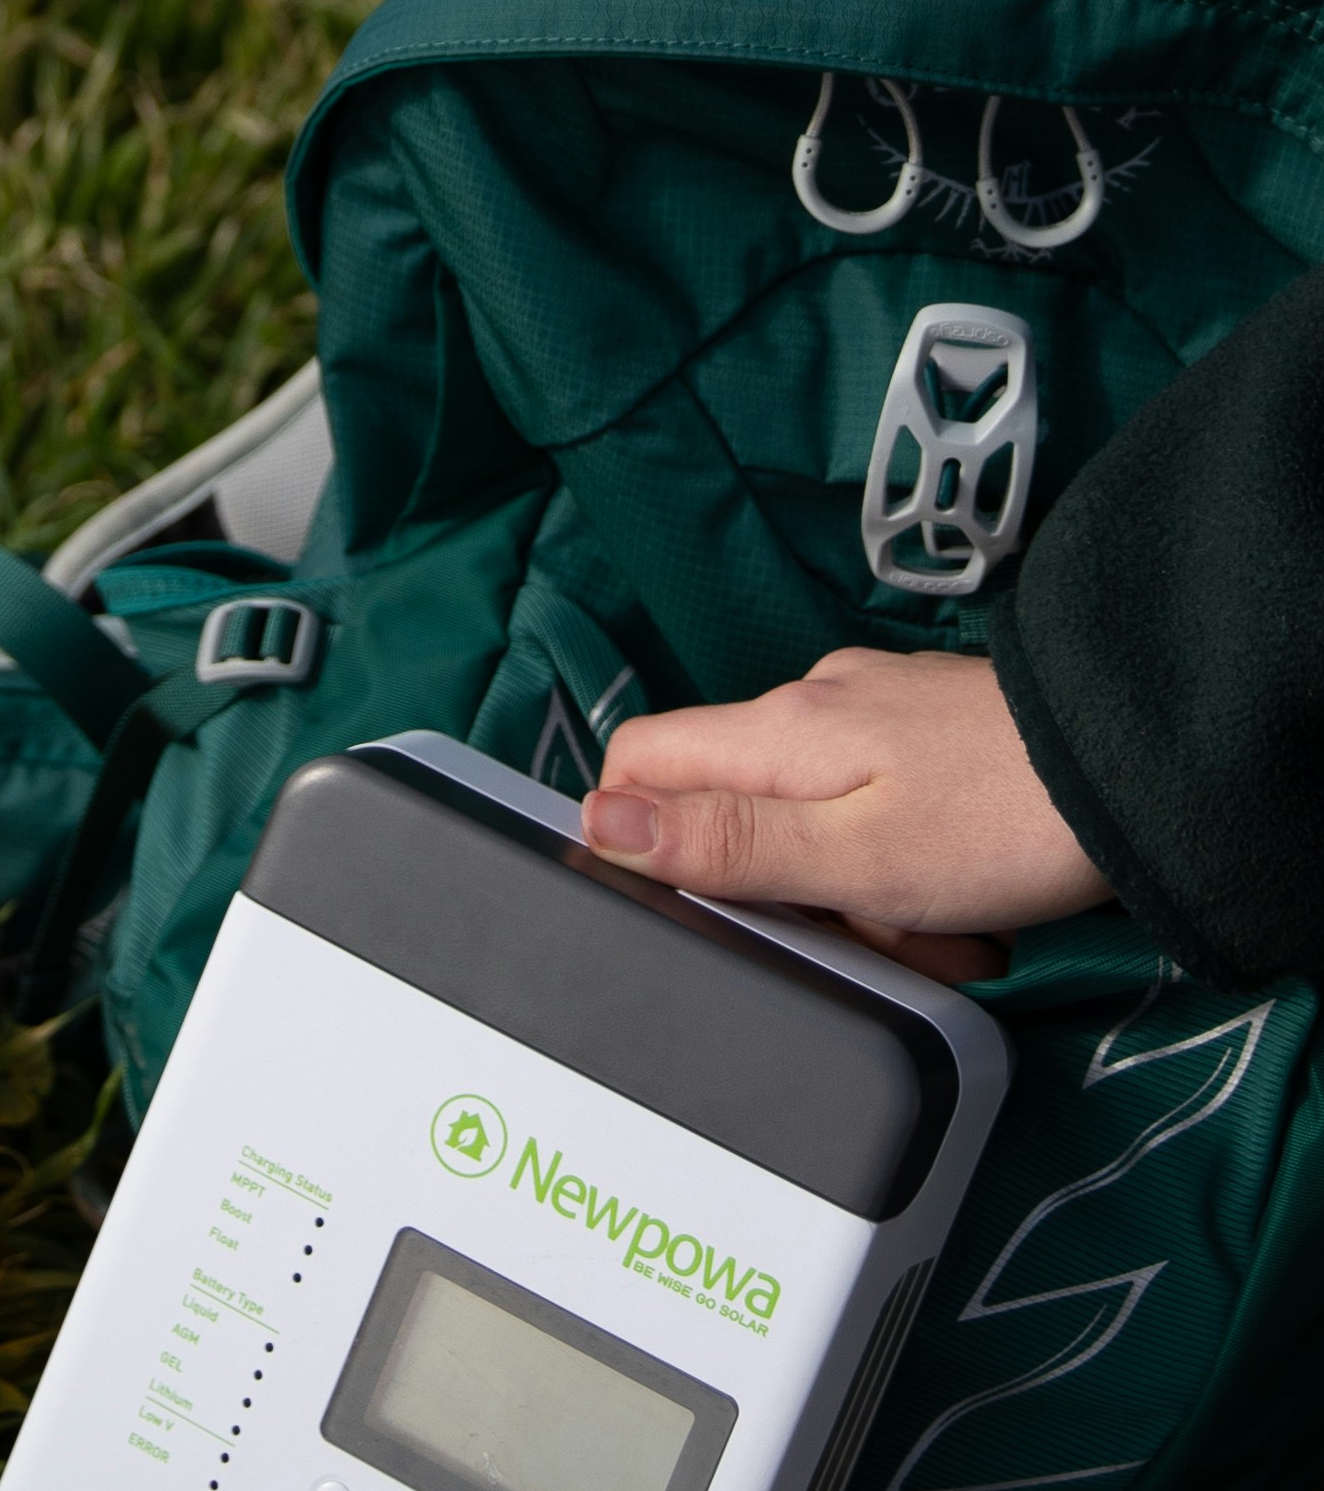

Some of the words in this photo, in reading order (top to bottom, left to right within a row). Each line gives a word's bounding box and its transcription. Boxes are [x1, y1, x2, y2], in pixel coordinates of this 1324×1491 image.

[230, 1172, 266, 1198] MPPT
[241, 1145, 293, 1184] Charging
[295, 1175, 333, 1202] Status
[220, 1199, 253, 1224] Boost
[208, 1226, 240, 1251] Float
[509, 1136, 781, 1319] Newpowa
[193, 1268, 236, 1301] Battery
[238, 1292, 264, 1316] Type
[632, 1260, 654, 1280] BE
[657, 1273, 693, 1299] WISE
[695, 1292, 716, 1310] GO
[719, 1304, 769, 1337] SOLAR
[182, 1294, 219, 1322] Liquid
[171, 1323, 201, 1346] AGM
[160, 1350, 183, 1373] GEL
[149, 1378, 193, 1411] Lithium
[138, 1405, 163, 1426] Low
[128, 1432, 170, 1464] ERROR
